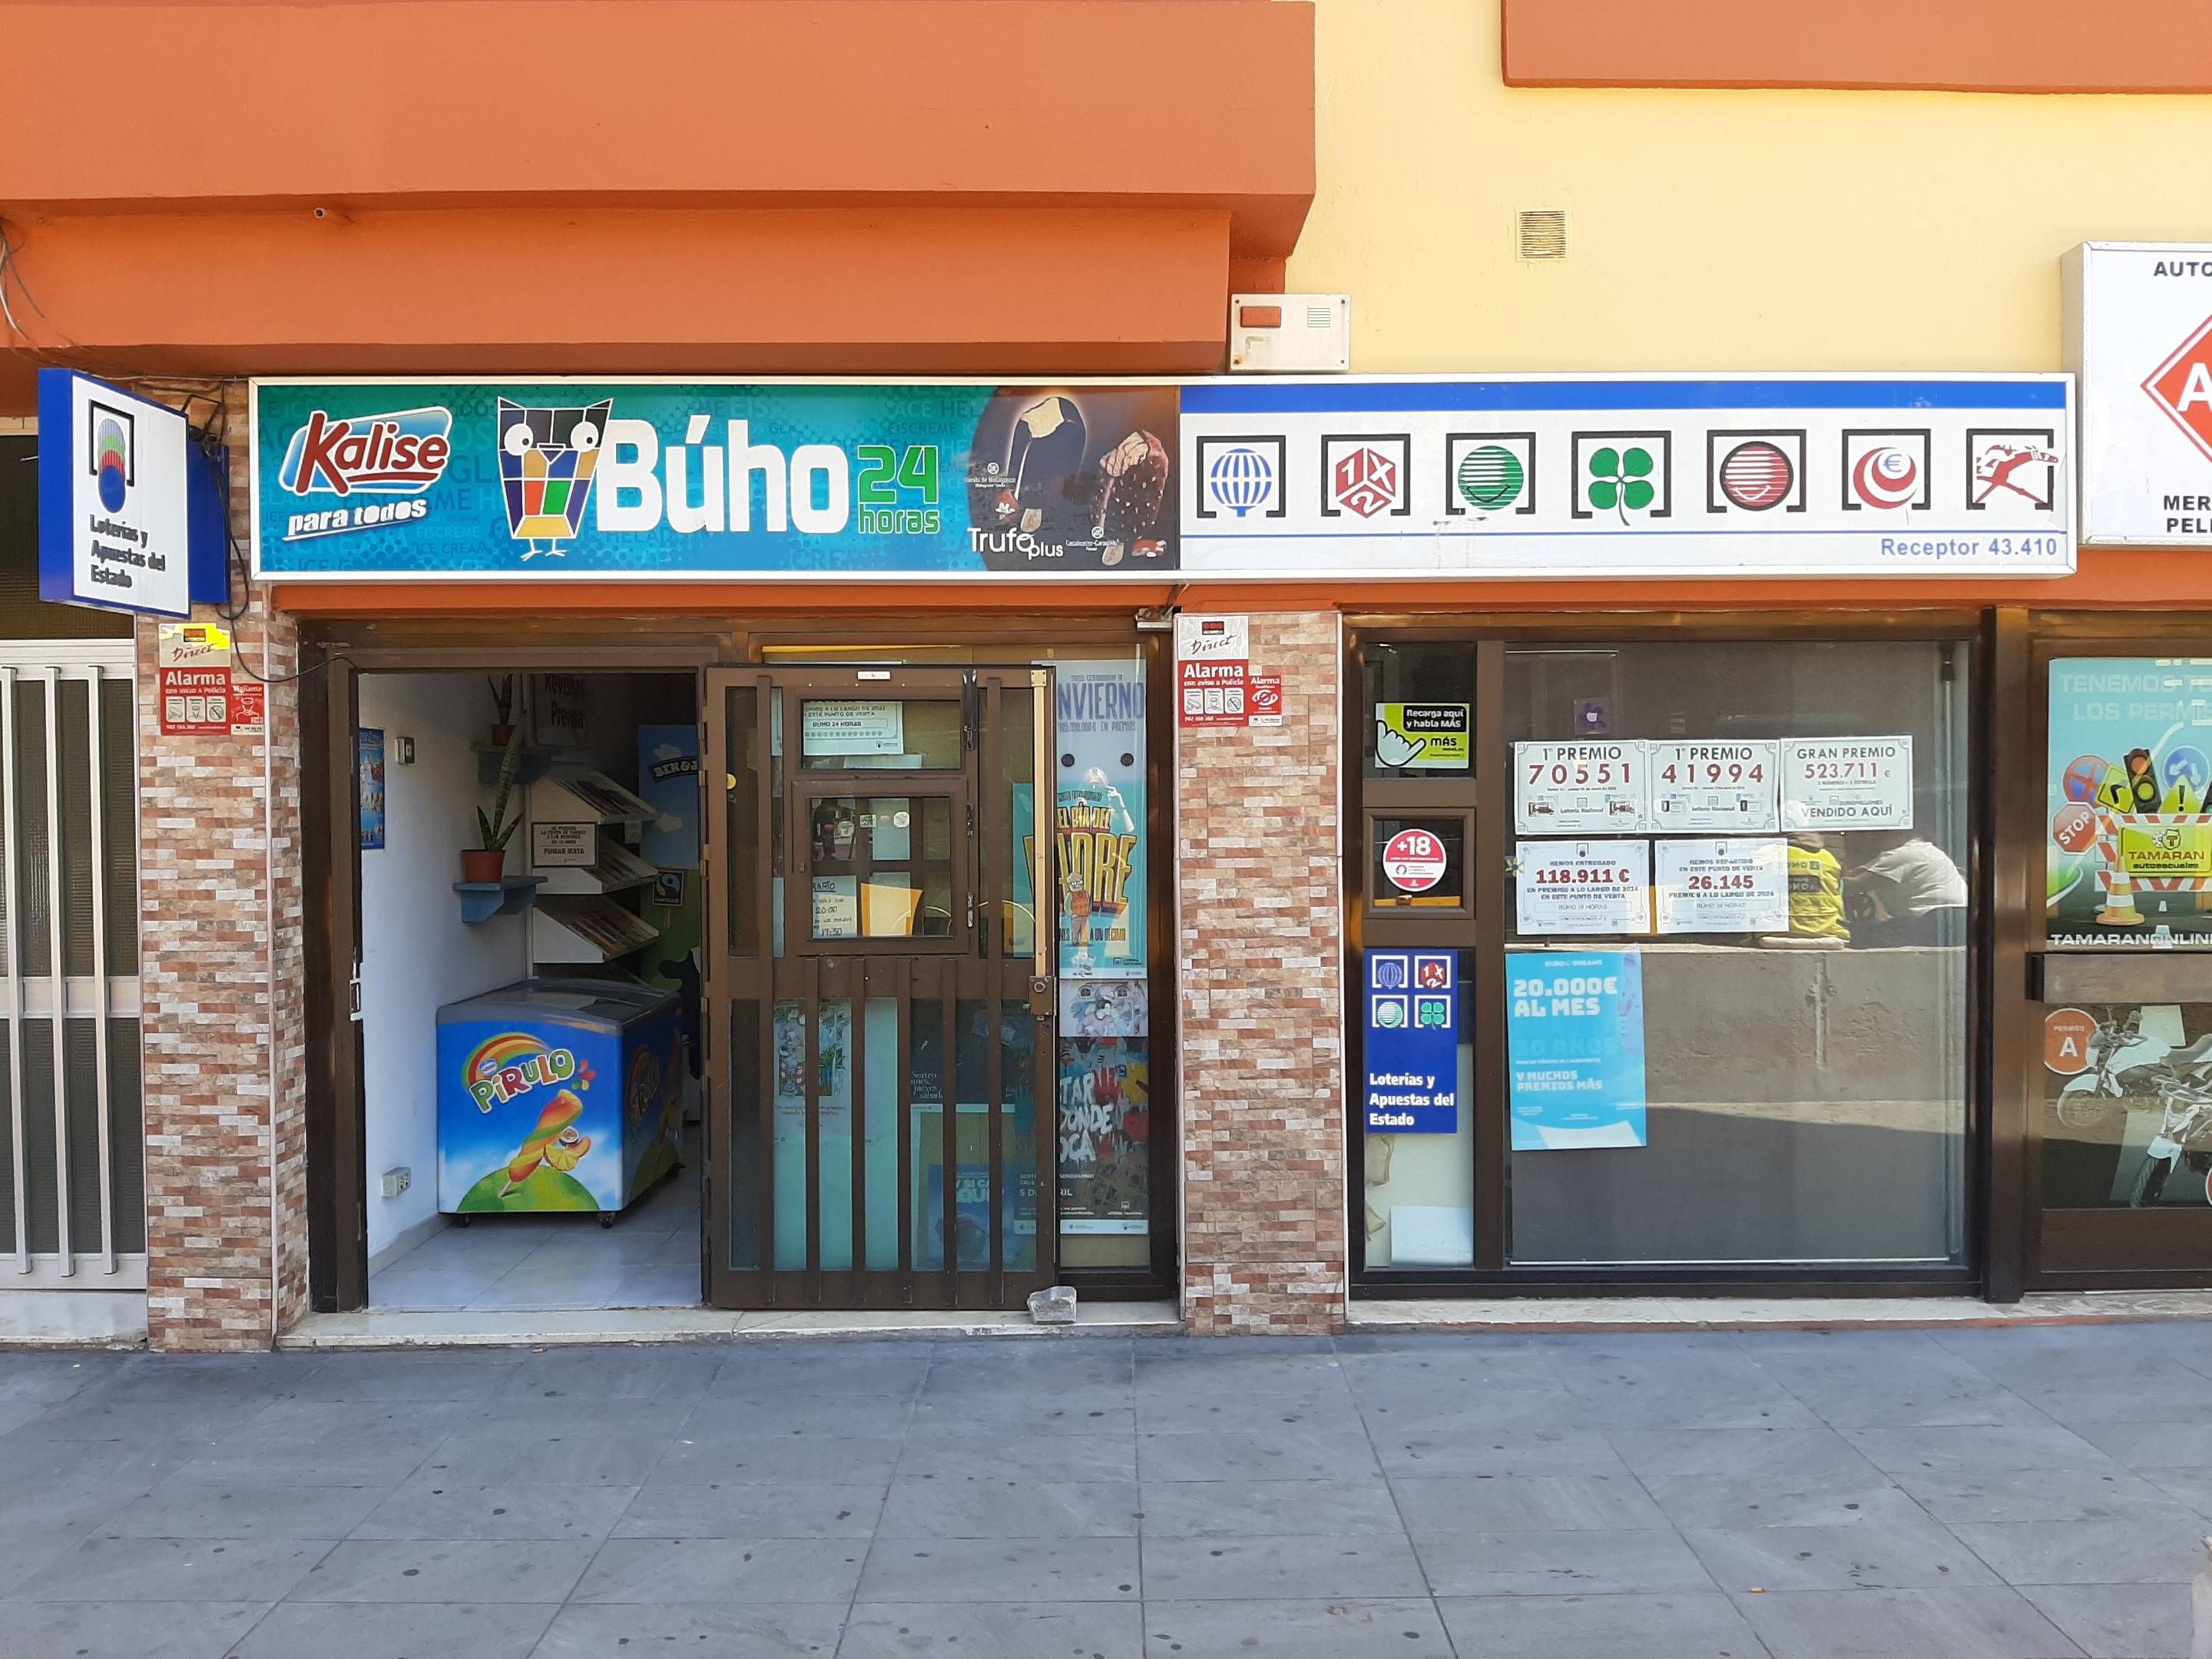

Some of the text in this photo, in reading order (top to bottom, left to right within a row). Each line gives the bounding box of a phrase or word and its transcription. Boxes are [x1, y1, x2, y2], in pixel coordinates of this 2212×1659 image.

[294, 411, 449, 495] Kalise
[596, 414, 849, 534] Búho
[857, 445, 939, 504] 24
[287, 508, 349, 537] para
[354, 499, 427, 525] todos
[857, 503, 940, 534] horas
[2167, 518, 2212, 533] PEL
[140, 531, 148, 549] y
[1881, 538, 2058, 560] Receptor 43.410
[1028, 542, 1064, 561] plus
[166, 671, 226, 686] Alarma
[1184, 663, 1244, 678] Alarma
[2059, 674, 2176, 693] TENEMOS
[1057, 682, 1145, 720] NVIERNO
[1406, 709, 1465, 720] Recarga aquí
[2074, 702, 2120, 722] LOS
[1441, 717, 1462, 728] MÁS
[1557, 746, 1622, 761] PREMIO
[1690, 746, 1753, 761] PREMIO
[1796, 747, 1896, 760] GRAN PREMIO
[1528, 763, 1631, 786] 70551
[1661, 763, 1764, 784] 41994
[1804, 762, 1892, 780] 523.711 €
[1801, 803, 1892, 818] VENDIDO AQUÍ
[2059, 810, 2090, 845] STOP
[1396, 836, 1431, 856] +18
[2128, 851, 2205, 860] TAMARAN
[1536, 869, 1630, 884] 118.911 €
[1688, 874, 1754, 890] 26.145
[2050, 933, 2212, 945] TAMARANONLIN
[1513, 976, 1618, 998] 20.000€
[1515, 998, 1601, 1018] AL MES
[2059, 1037, 2078, 1057] A
[1369, 1072, 1435, 1089] Loterías y
[1516, 1070, 1578, 1081] Y MUCHOS
[1517, 1077, 1603, 1091] PREMIOS MÁS
[1369, 1092, 1455, 1108] Apuestas del
[1369, 1112, 1415, 1126] Estado
